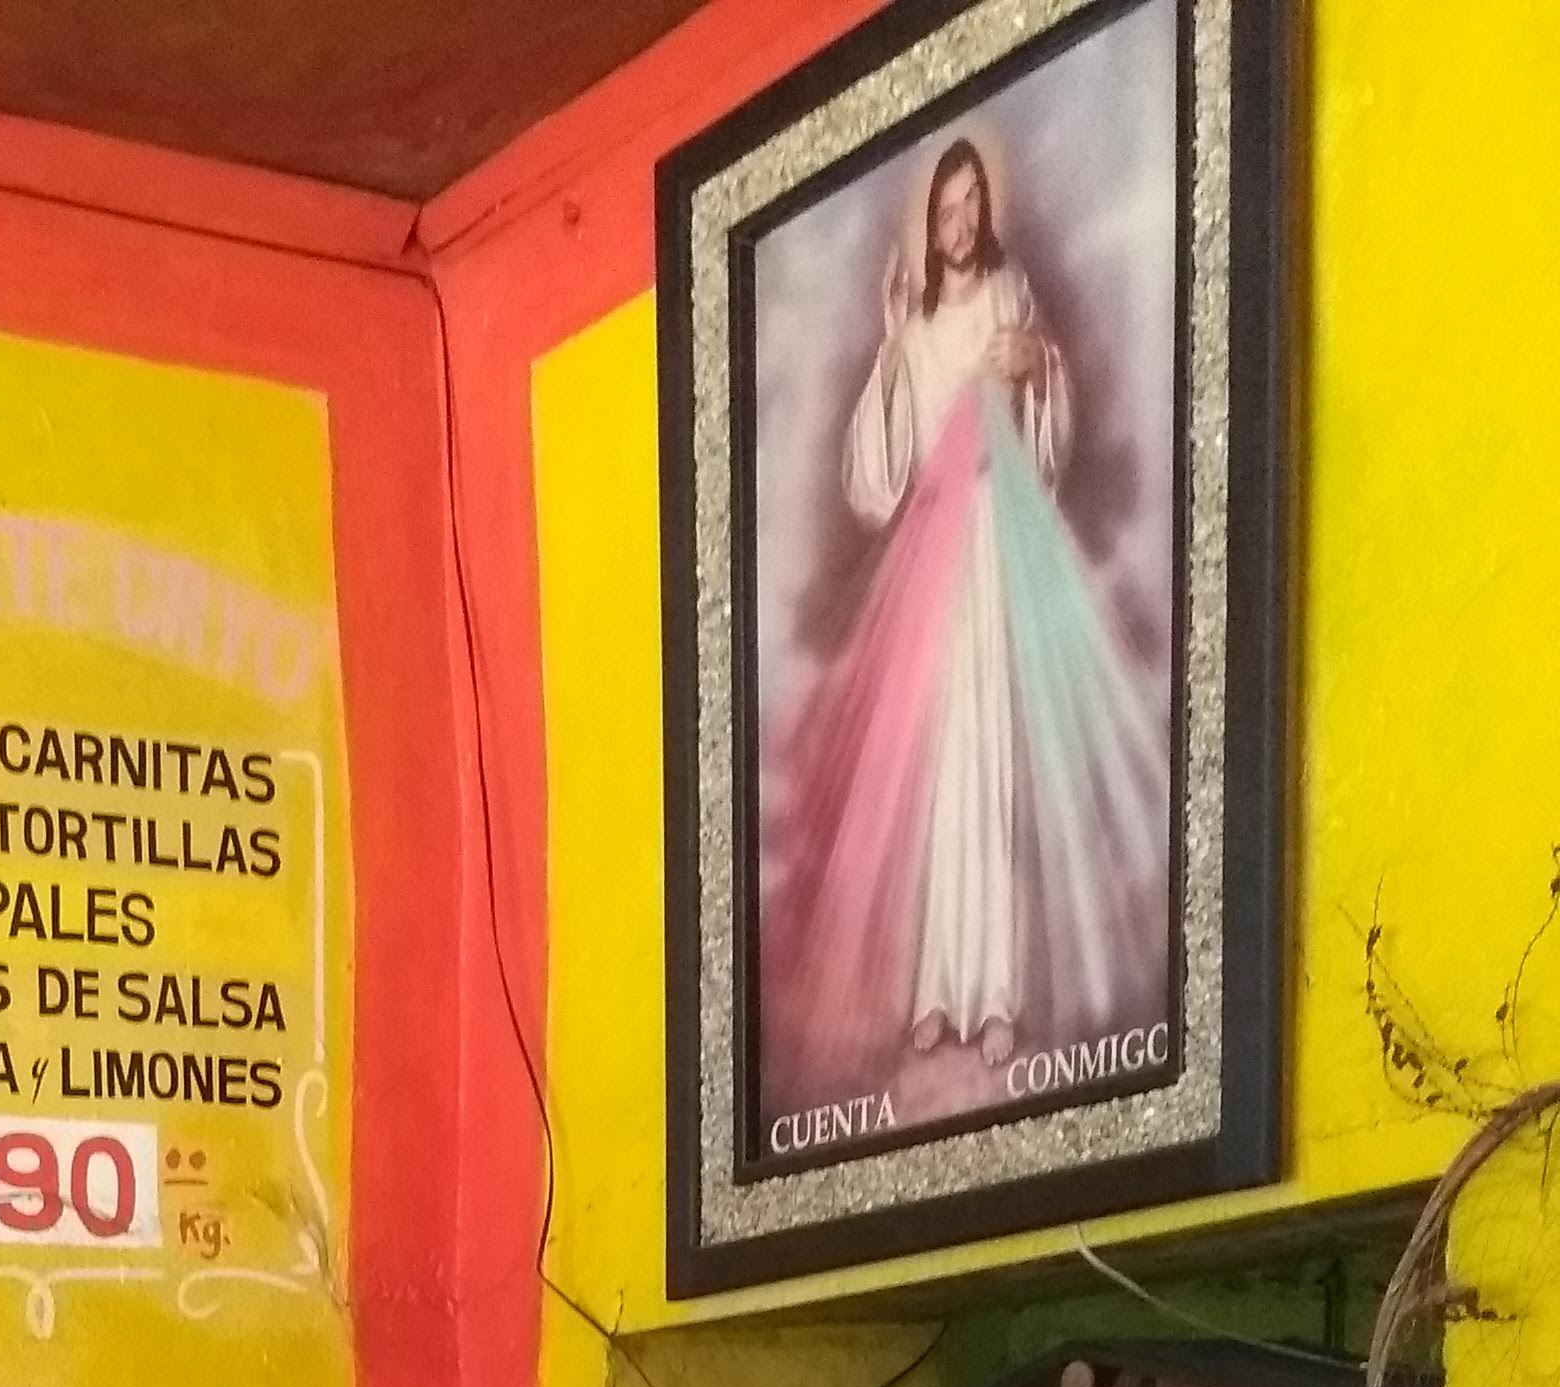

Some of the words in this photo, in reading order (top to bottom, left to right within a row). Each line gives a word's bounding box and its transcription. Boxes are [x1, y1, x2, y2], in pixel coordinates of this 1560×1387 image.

[38, 965, 99, 1019] DE
[117, 972, 286, 1031] SALSA
[31, 1057, 49, 1105] y
[61, 1047, 282, 1109] LIMONES
[769, 1091, 897, 1156] CUENTA
[1006, 1022, 1169, 1099] CONMIGO
